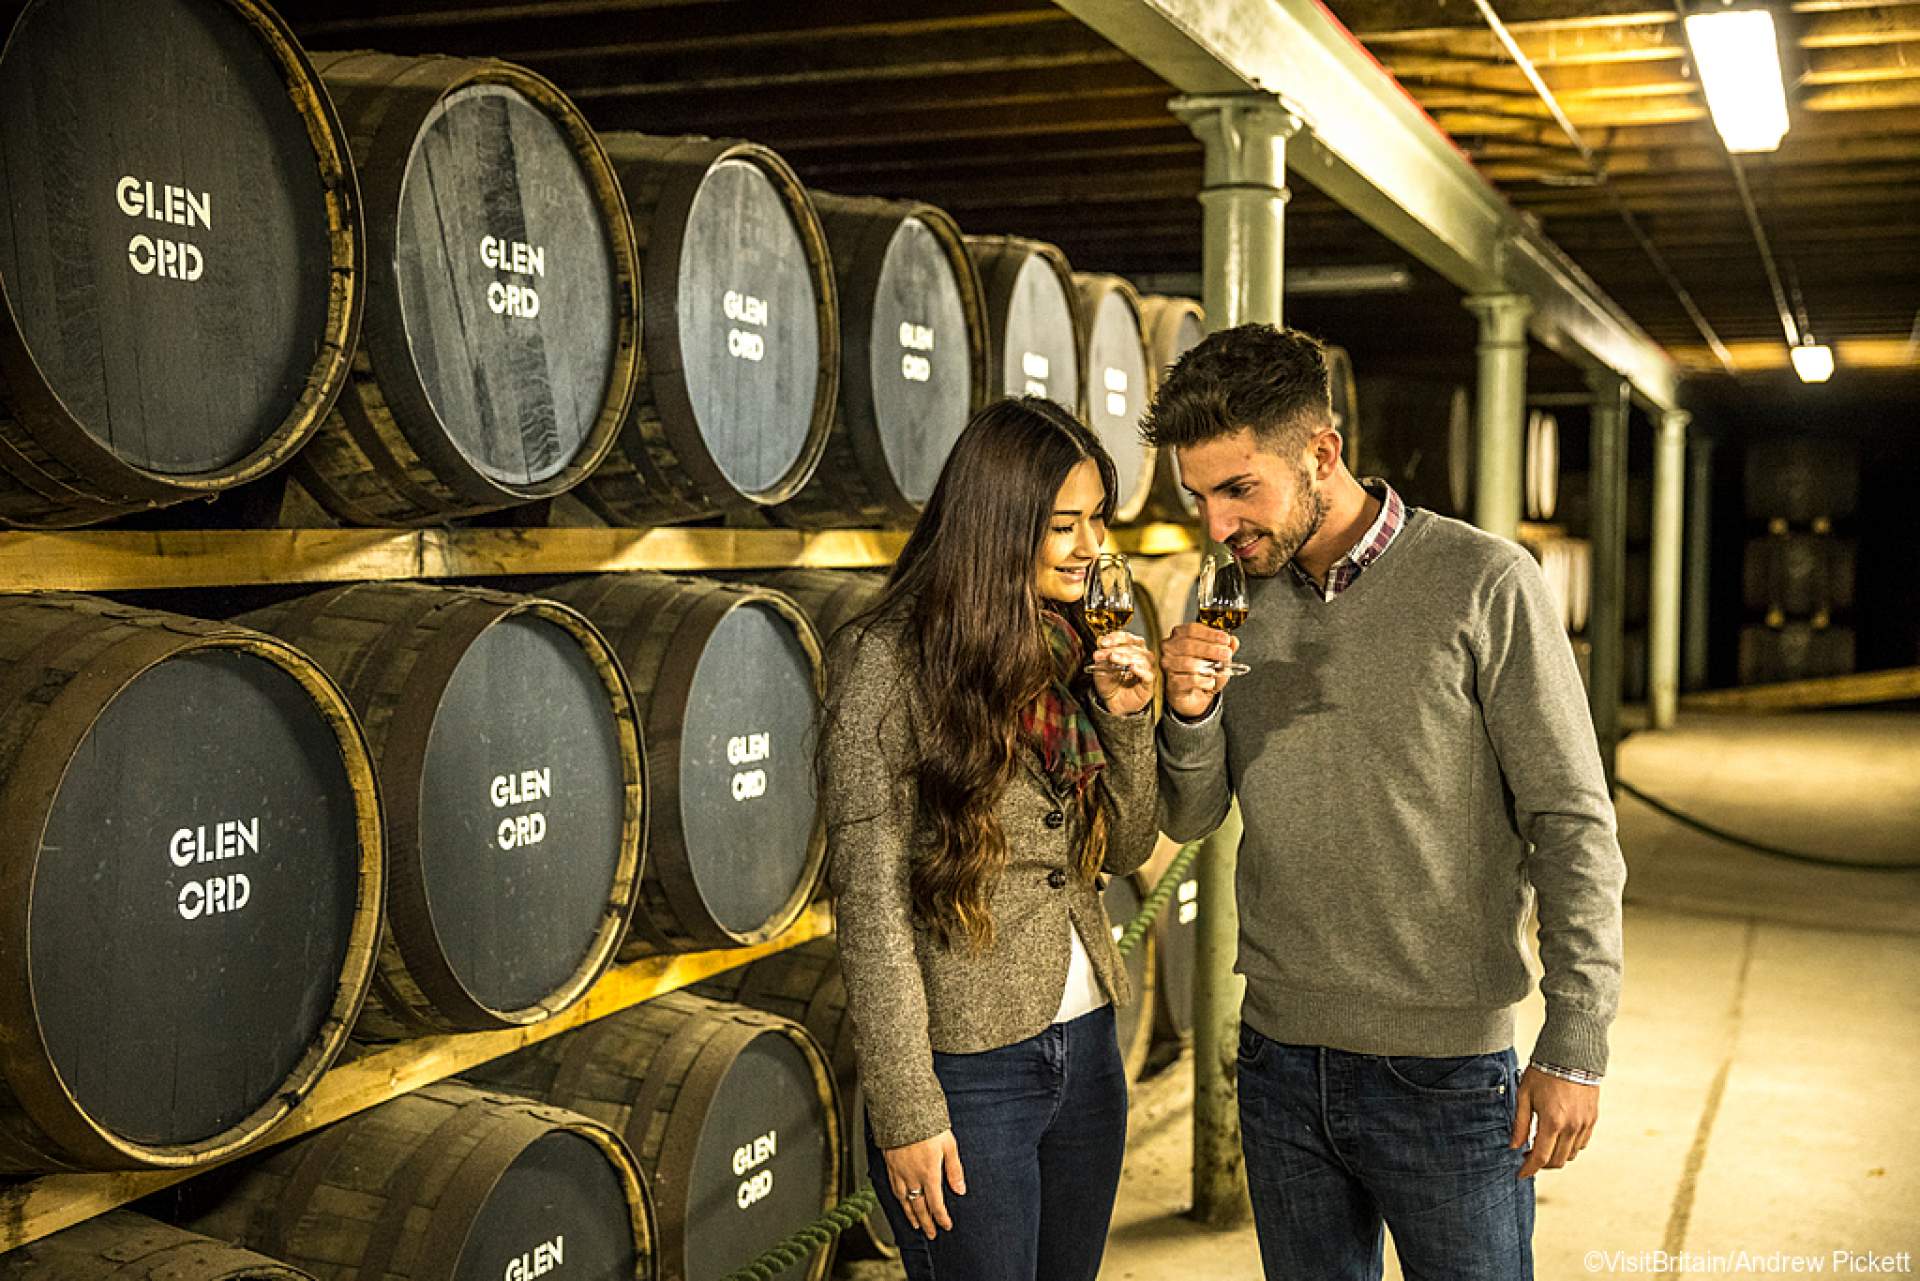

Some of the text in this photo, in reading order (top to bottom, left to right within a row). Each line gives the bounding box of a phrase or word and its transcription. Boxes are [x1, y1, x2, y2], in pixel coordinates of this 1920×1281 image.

[116, 175, 211, 230] GLEN
[128, 235, 204, 282] ORD
[479, 235, 545, 277] GLEN
[487, 282, 541, 319] ORD
[723, 290, 768, 327] GLEN
[728, 328, 764, 361] ORD
[727, 731, 770, 766] GLEN
[490, 766, 551, 807] GLEN
[731, 768, 766, 802] ORD
[170, 817, 259, 868] GLEN
[498, 811, 547, 851] ORD
[177, 873, 250, 920] ORD
[732, 1130, 776, 1176] GLEN
[736, 1169, 773, 1209] ORD
[505, 1235, 563, 1281] GLEN
